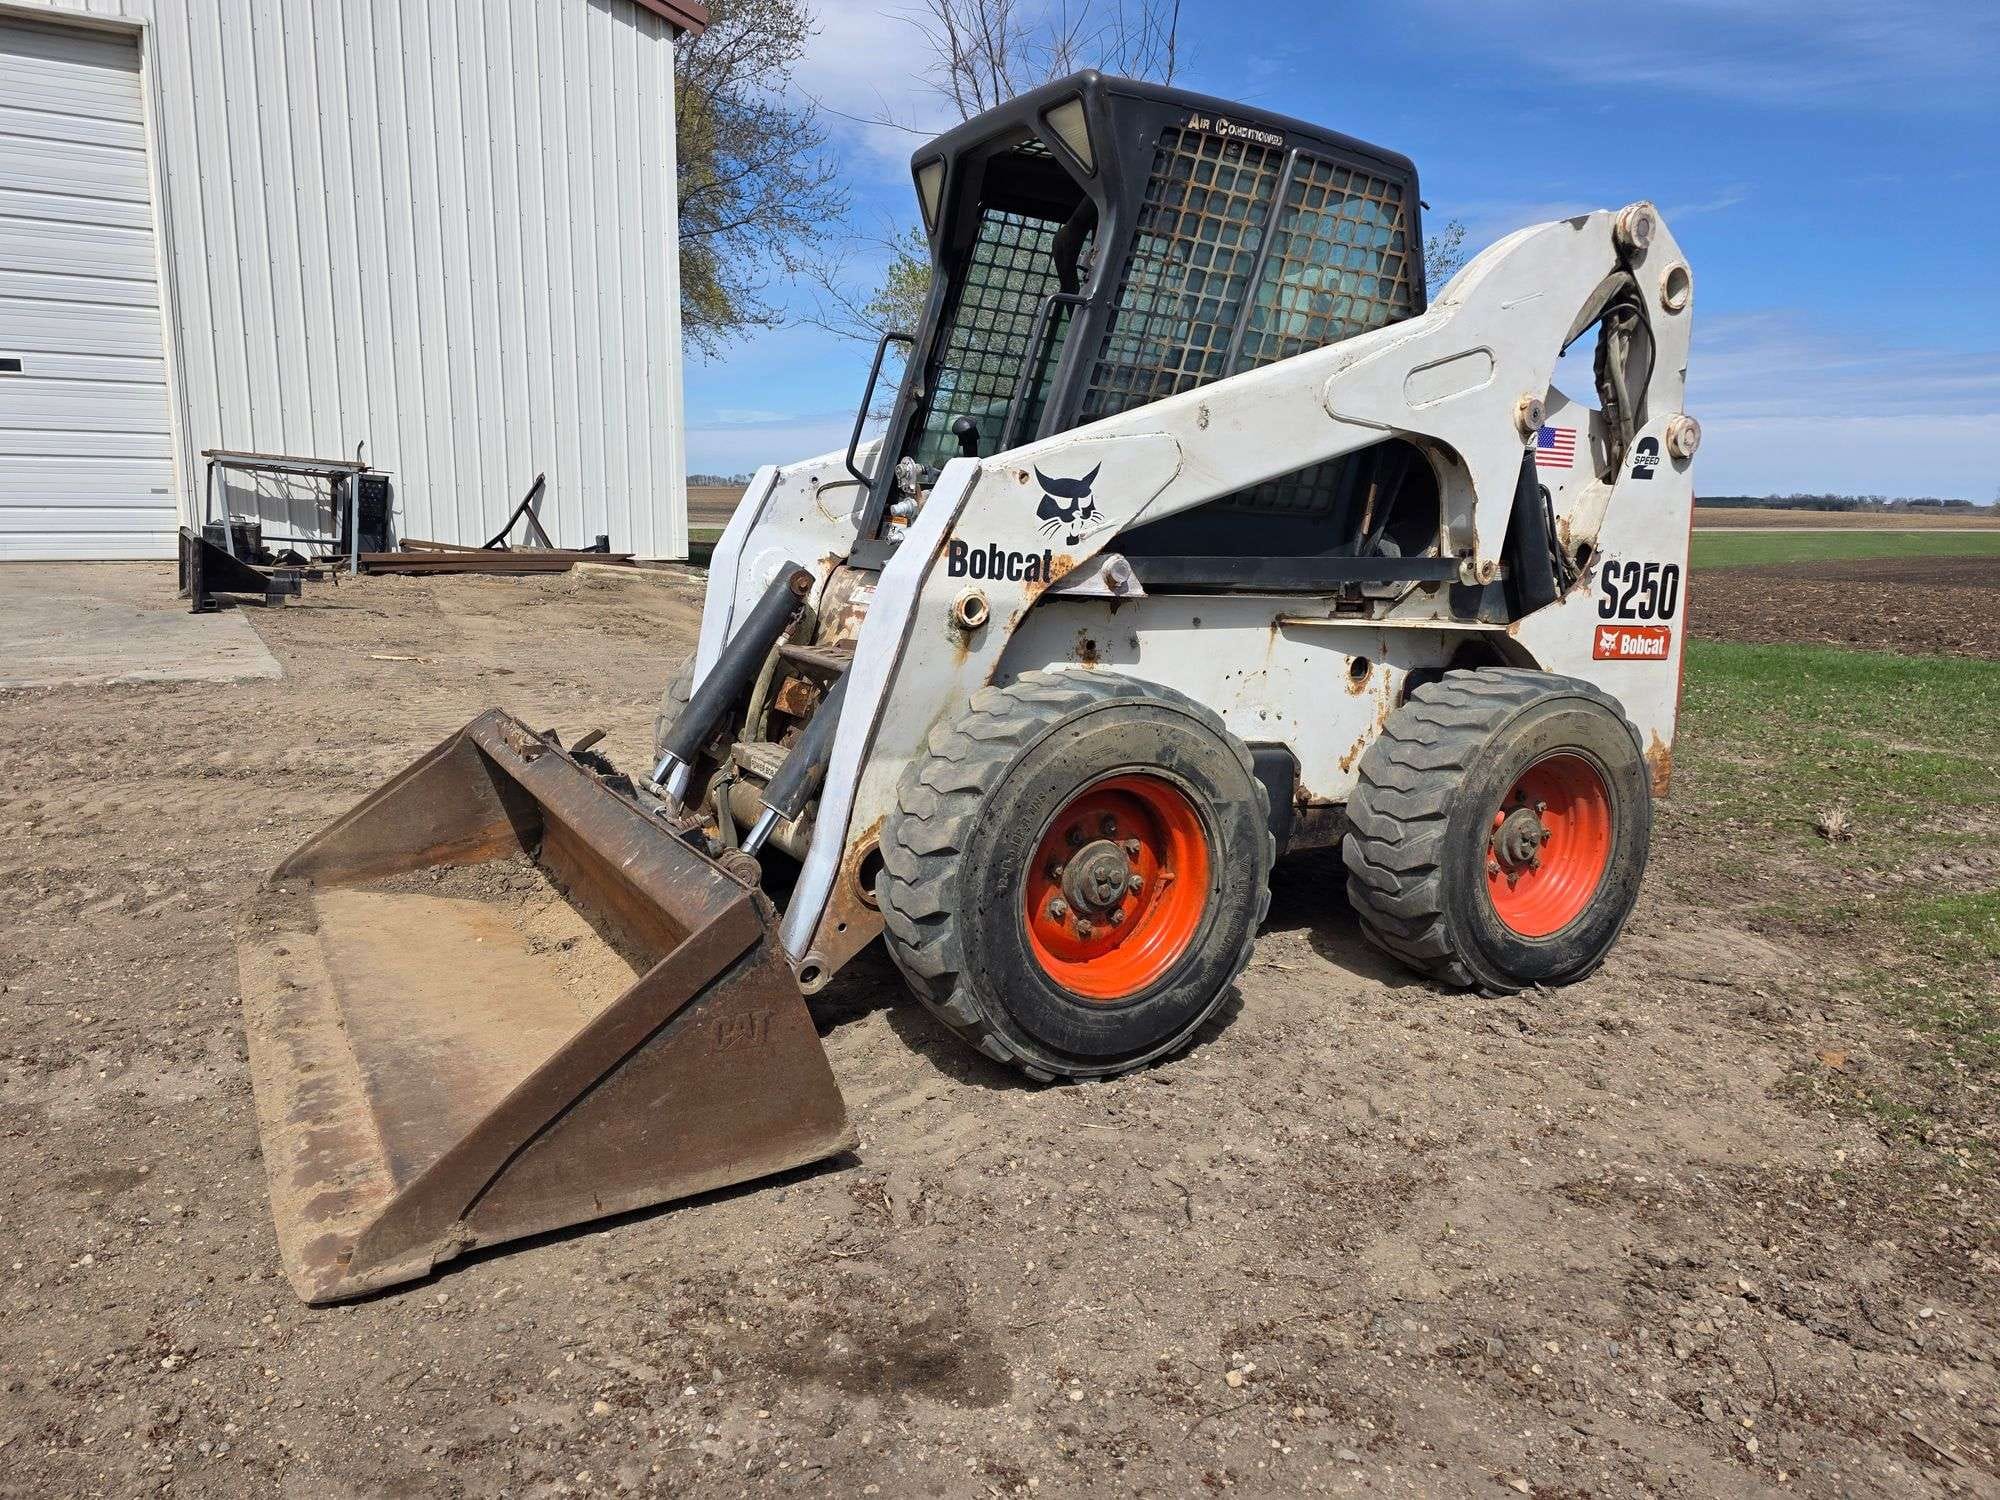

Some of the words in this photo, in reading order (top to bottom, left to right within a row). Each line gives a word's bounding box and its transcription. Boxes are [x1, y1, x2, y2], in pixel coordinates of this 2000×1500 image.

[1188, 112, 1211, 130] AIR
[1631, 436, 1659, 480] 2
[1634, 455, 1660, 465] SPEED
[947, 538, 1053, 583] Bobcat
[1598, 560, 1680, 620] S250
[1620, 634, 1665, 655] Bobcat
